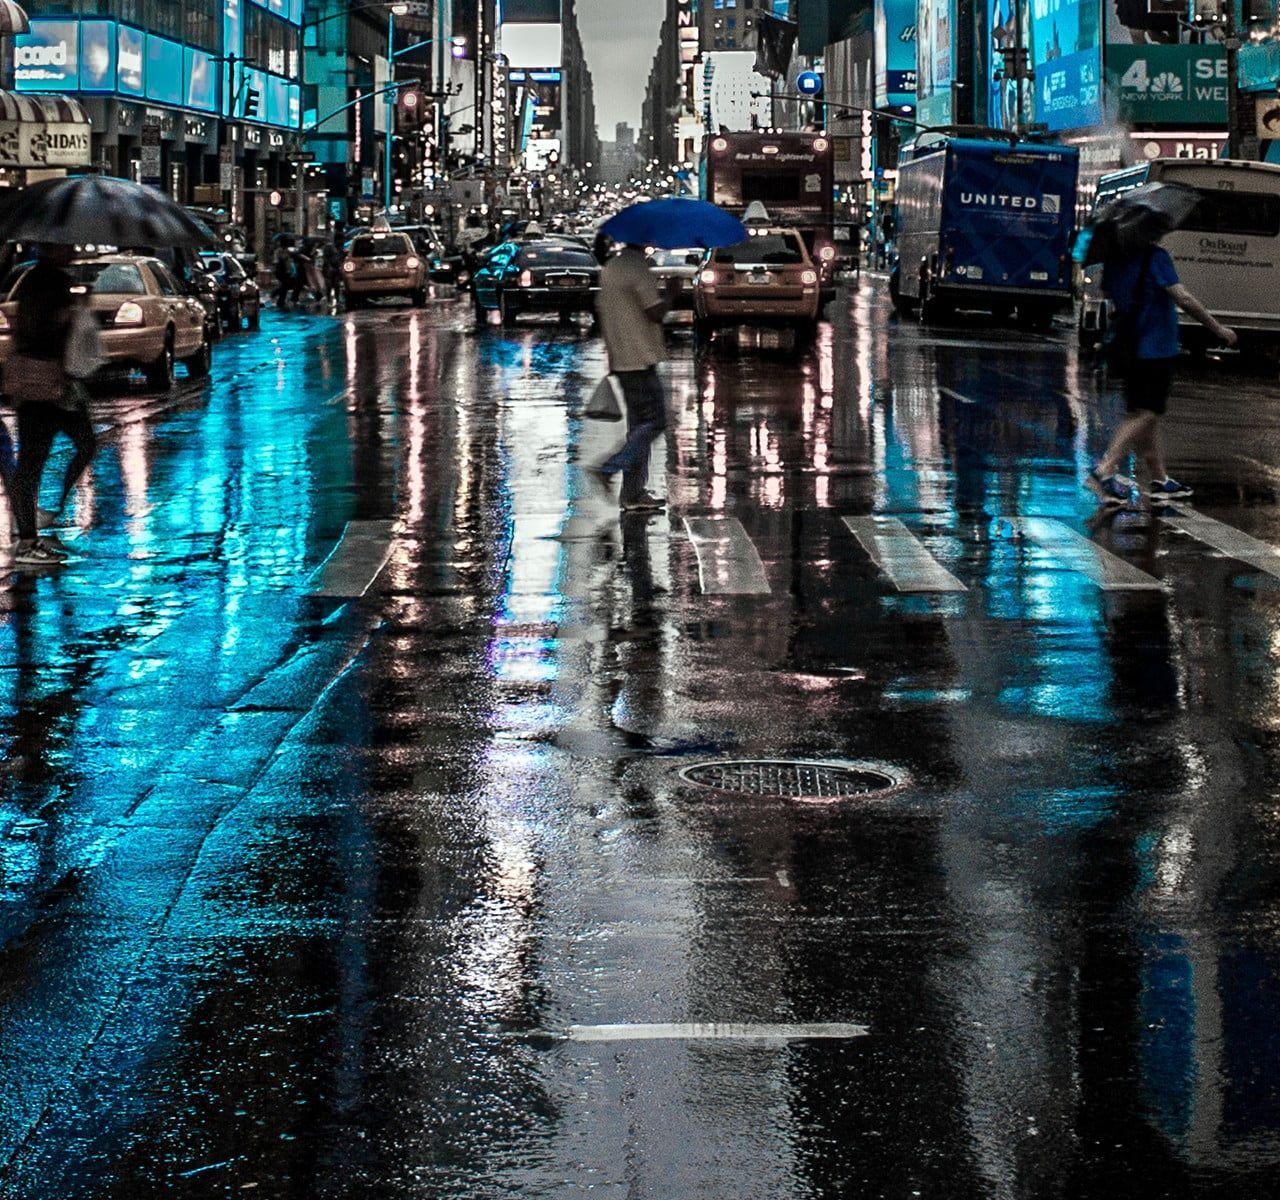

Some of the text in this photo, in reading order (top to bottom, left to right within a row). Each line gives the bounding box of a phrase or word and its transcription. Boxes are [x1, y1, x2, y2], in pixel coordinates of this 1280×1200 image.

[1121, 59, 1150, 92] 4
[1151, 92, 1184, 101] YORK
[960, 191, 1037, 209] UNITED
